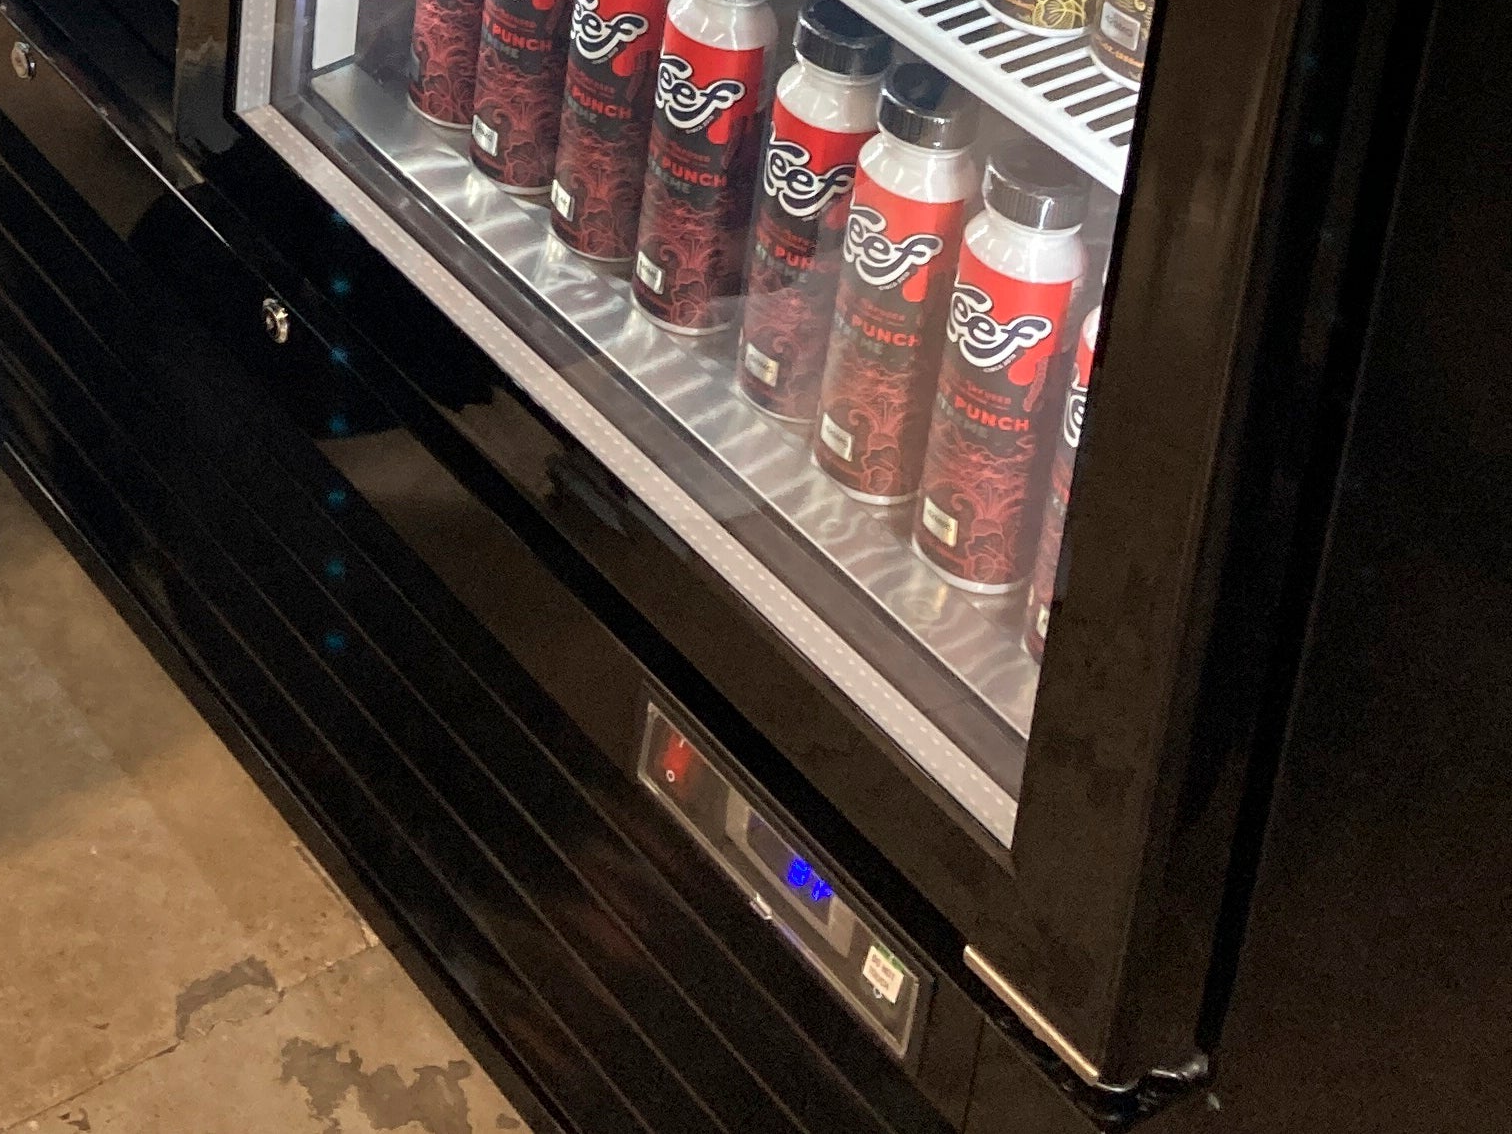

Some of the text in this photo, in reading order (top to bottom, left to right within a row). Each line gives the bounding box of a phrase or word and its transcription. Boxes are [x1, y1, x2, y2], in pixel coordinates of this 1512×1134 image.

[491, 22, 553, 52] PUNCH
[571, 85, 633, 119] PUNCH
[662, 154, 728, 189] PUNCH
[954, 395, 1031, 432] PUNCH
